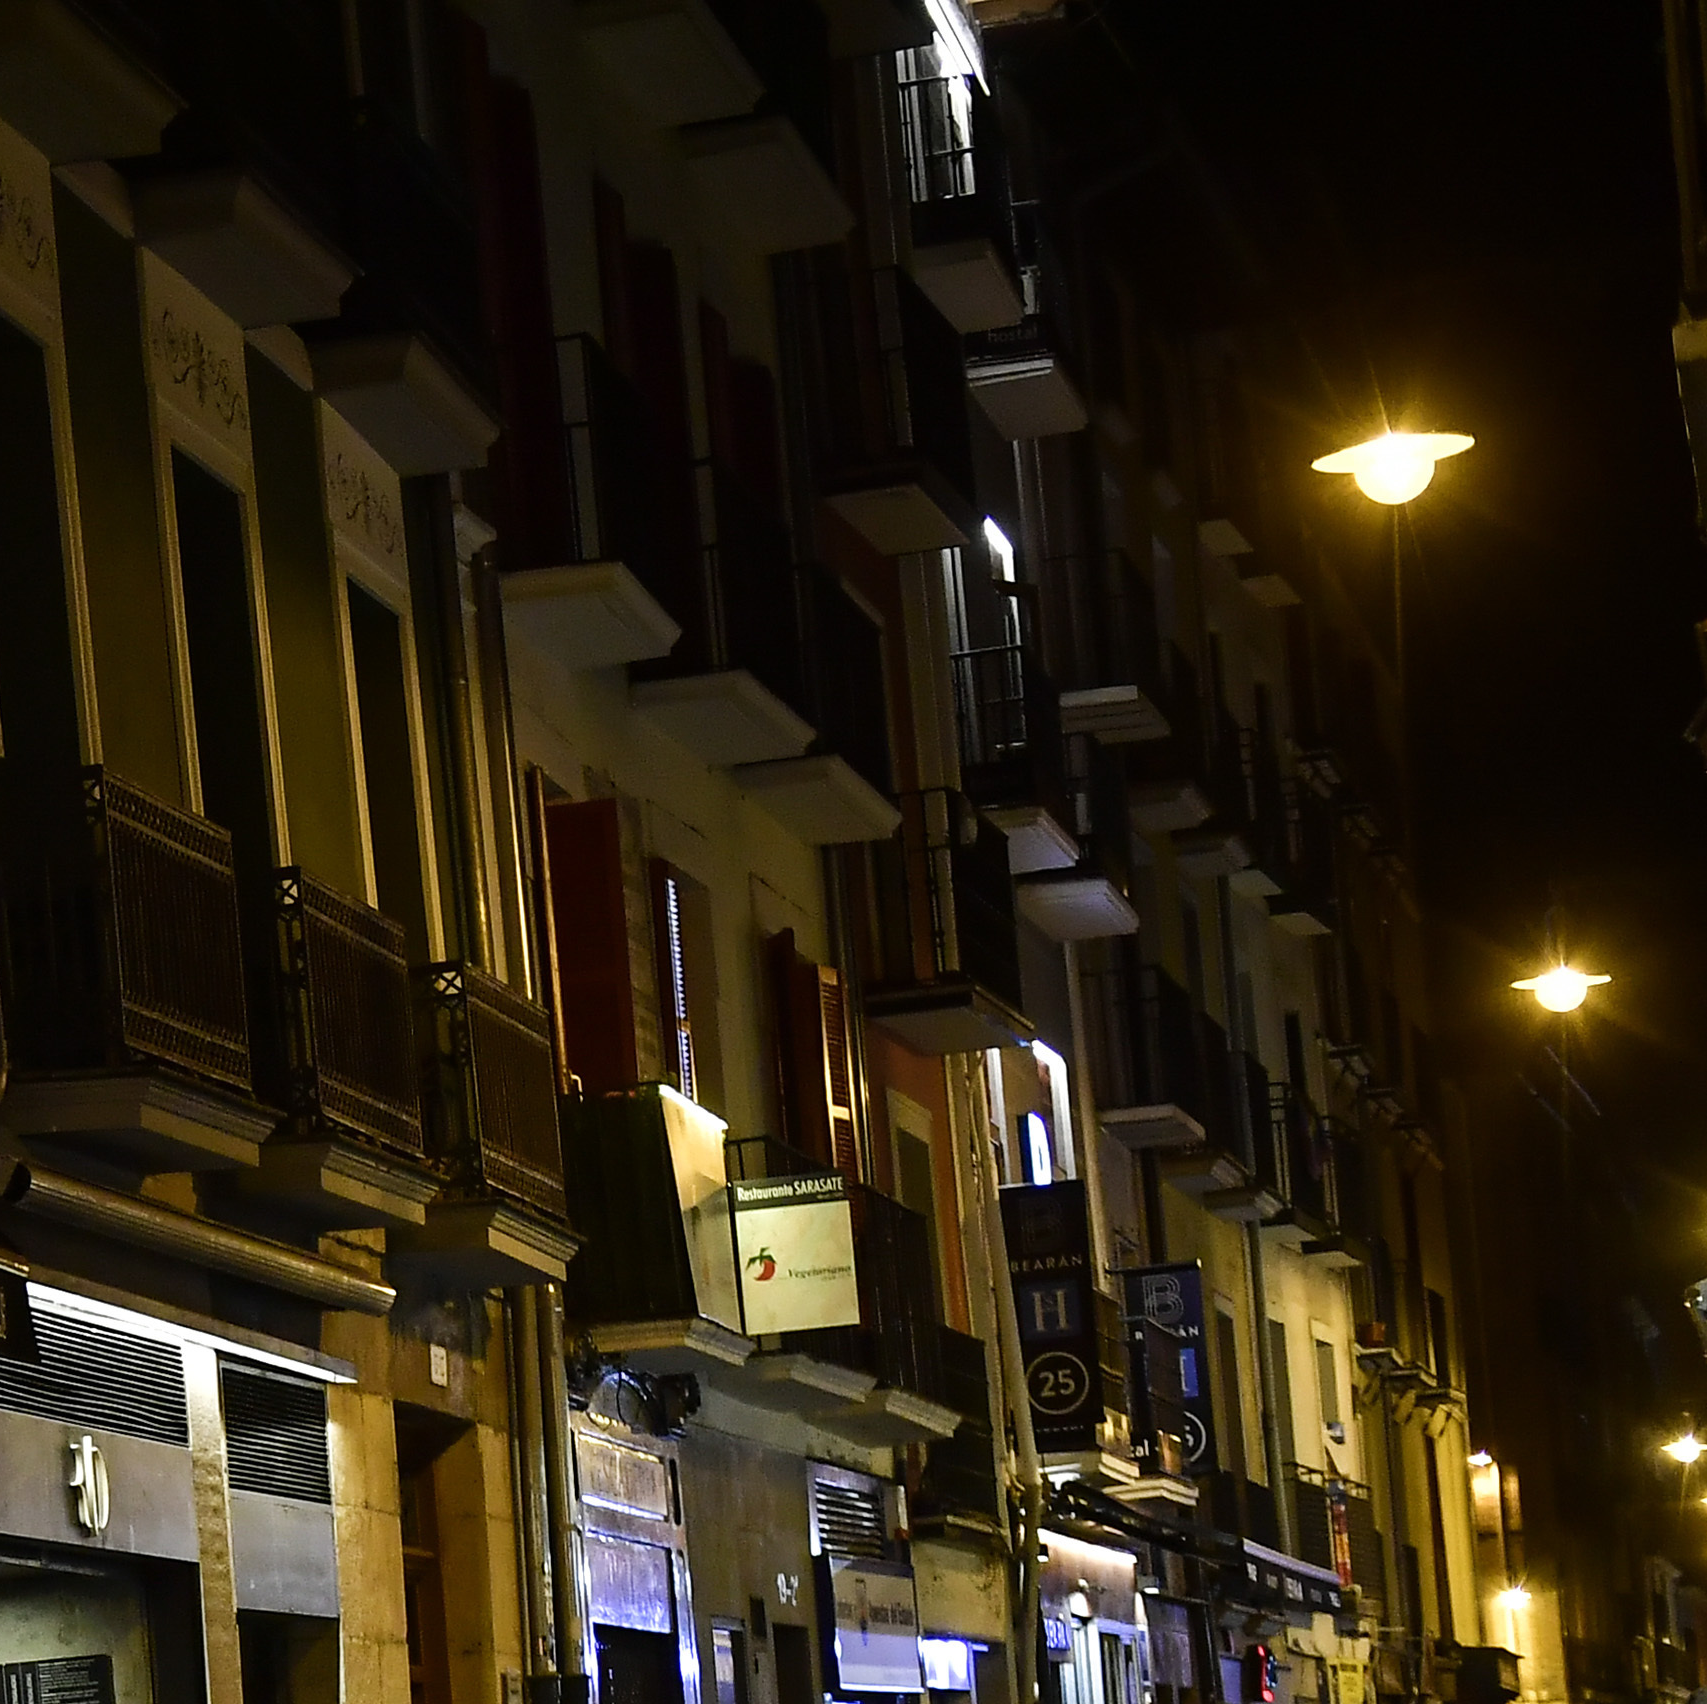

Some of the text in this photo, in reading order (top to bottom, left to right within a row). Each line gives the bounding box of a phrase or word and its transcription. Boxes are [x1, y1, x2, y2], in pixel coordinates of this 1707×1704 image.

[737, 1176, 844, 1202] Restaurante SARASATE
[1038, 1369, 1075, 1398] 25
